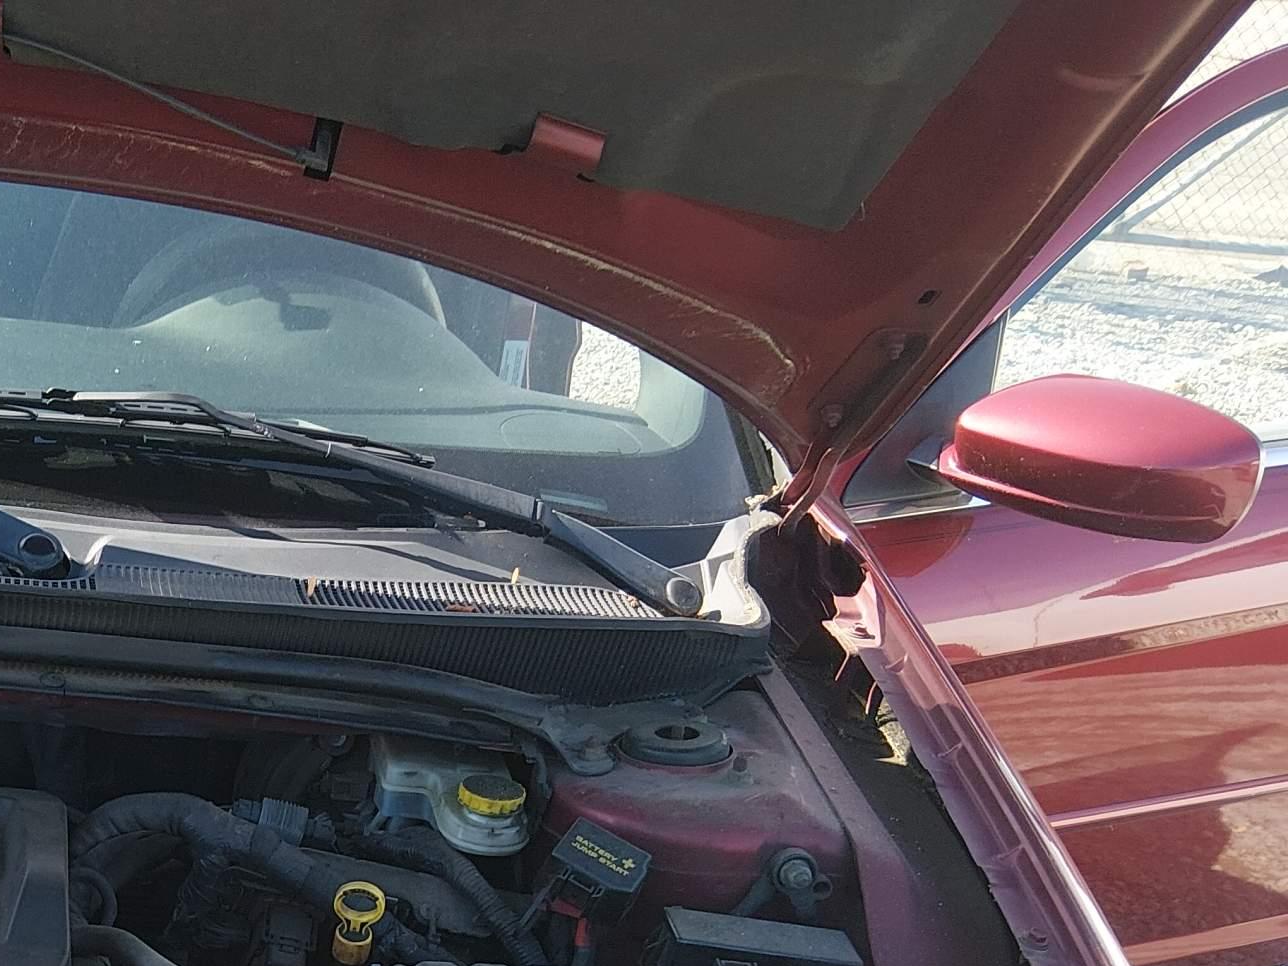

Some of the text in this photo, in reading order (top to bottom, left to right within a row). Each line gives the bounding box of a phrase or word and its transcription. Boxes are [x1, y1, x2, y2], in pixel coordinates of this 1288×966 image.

[571, 841, 630, 877] JUMP START
[575, 835, 618, 862] BATTERY
